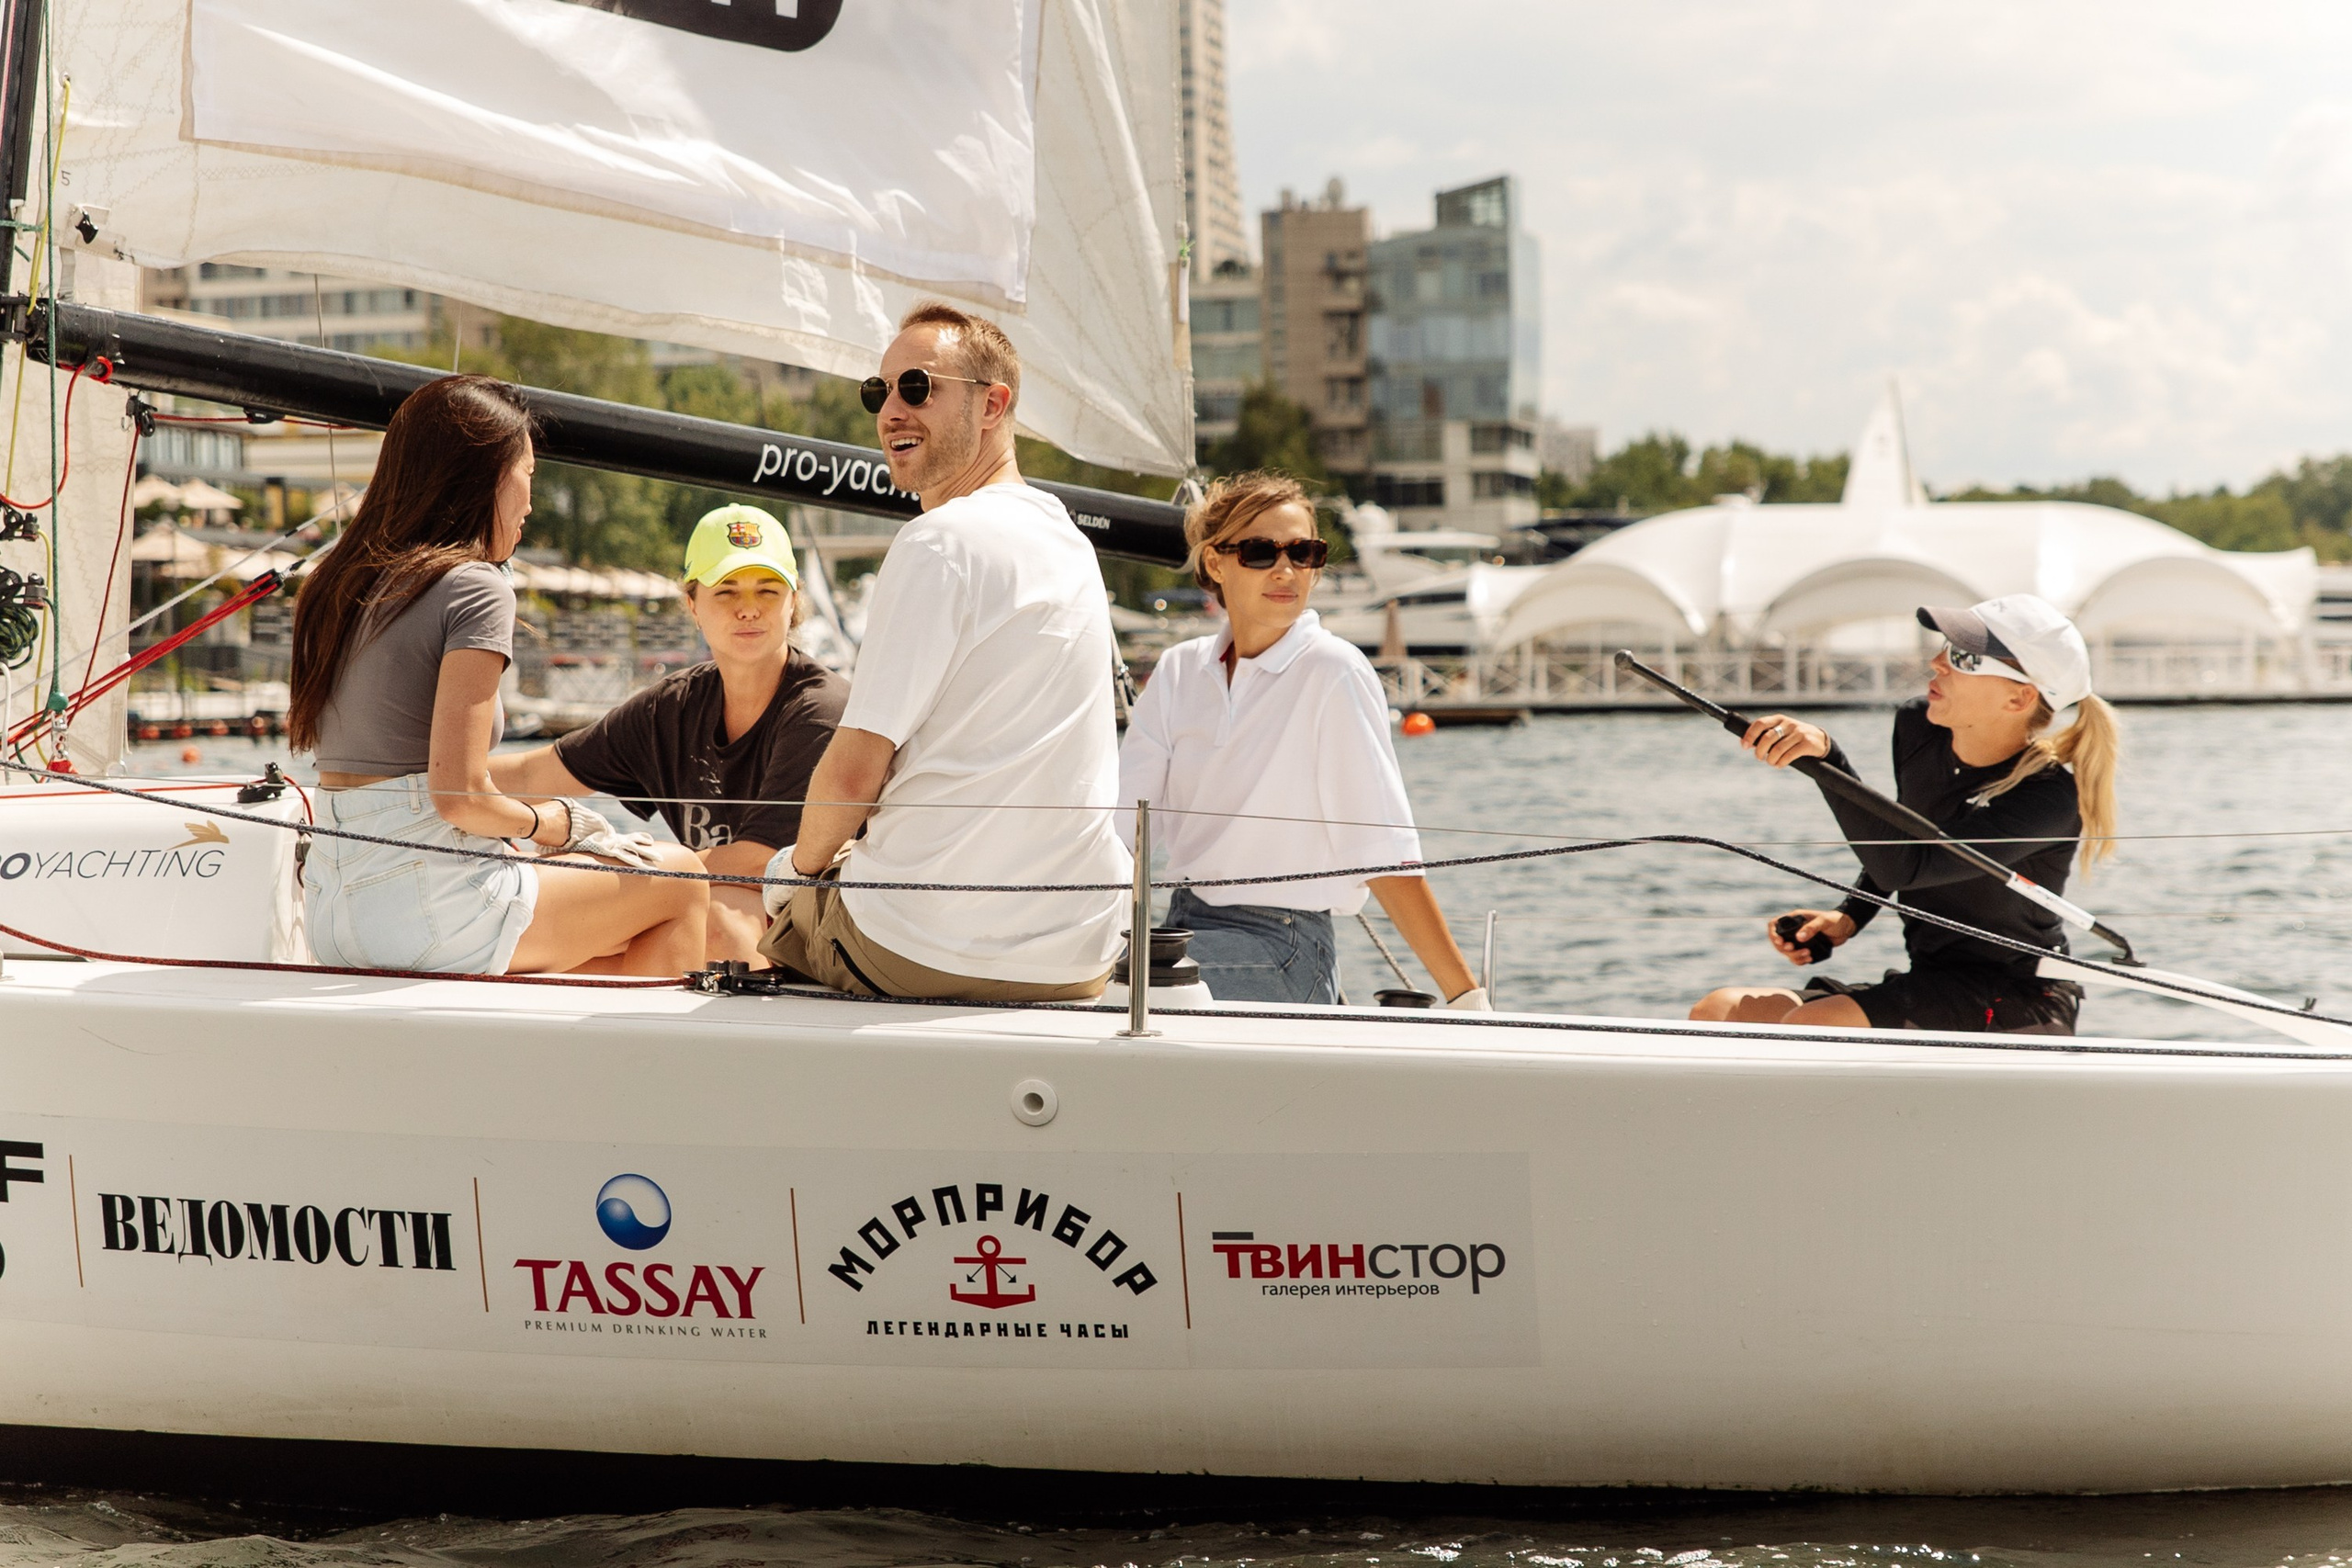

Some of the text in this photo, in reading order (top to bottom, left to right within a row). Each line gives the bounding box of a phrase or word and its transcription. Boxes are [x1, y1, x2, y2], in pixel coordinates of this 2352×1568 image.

[752, 444, 920, 502] pro-yac
[0, 849, 225, 880] OYACHTING
[97, 1192, 457, 1271] ВЕДОМОСТИ
[827, 1182, 1159, 1297] МОРПРИБОР
[513, 1258, 766, 1320] TASSAY
[1261, 1283, 1441, 1300] галерея интерьеров
[524, 1319, 768, 1339] PREMIUM DRINKING WATER
[866, 1320, 1129, 1339] ЛЕГЕНДАРНЫЕ ЧАСЫ
